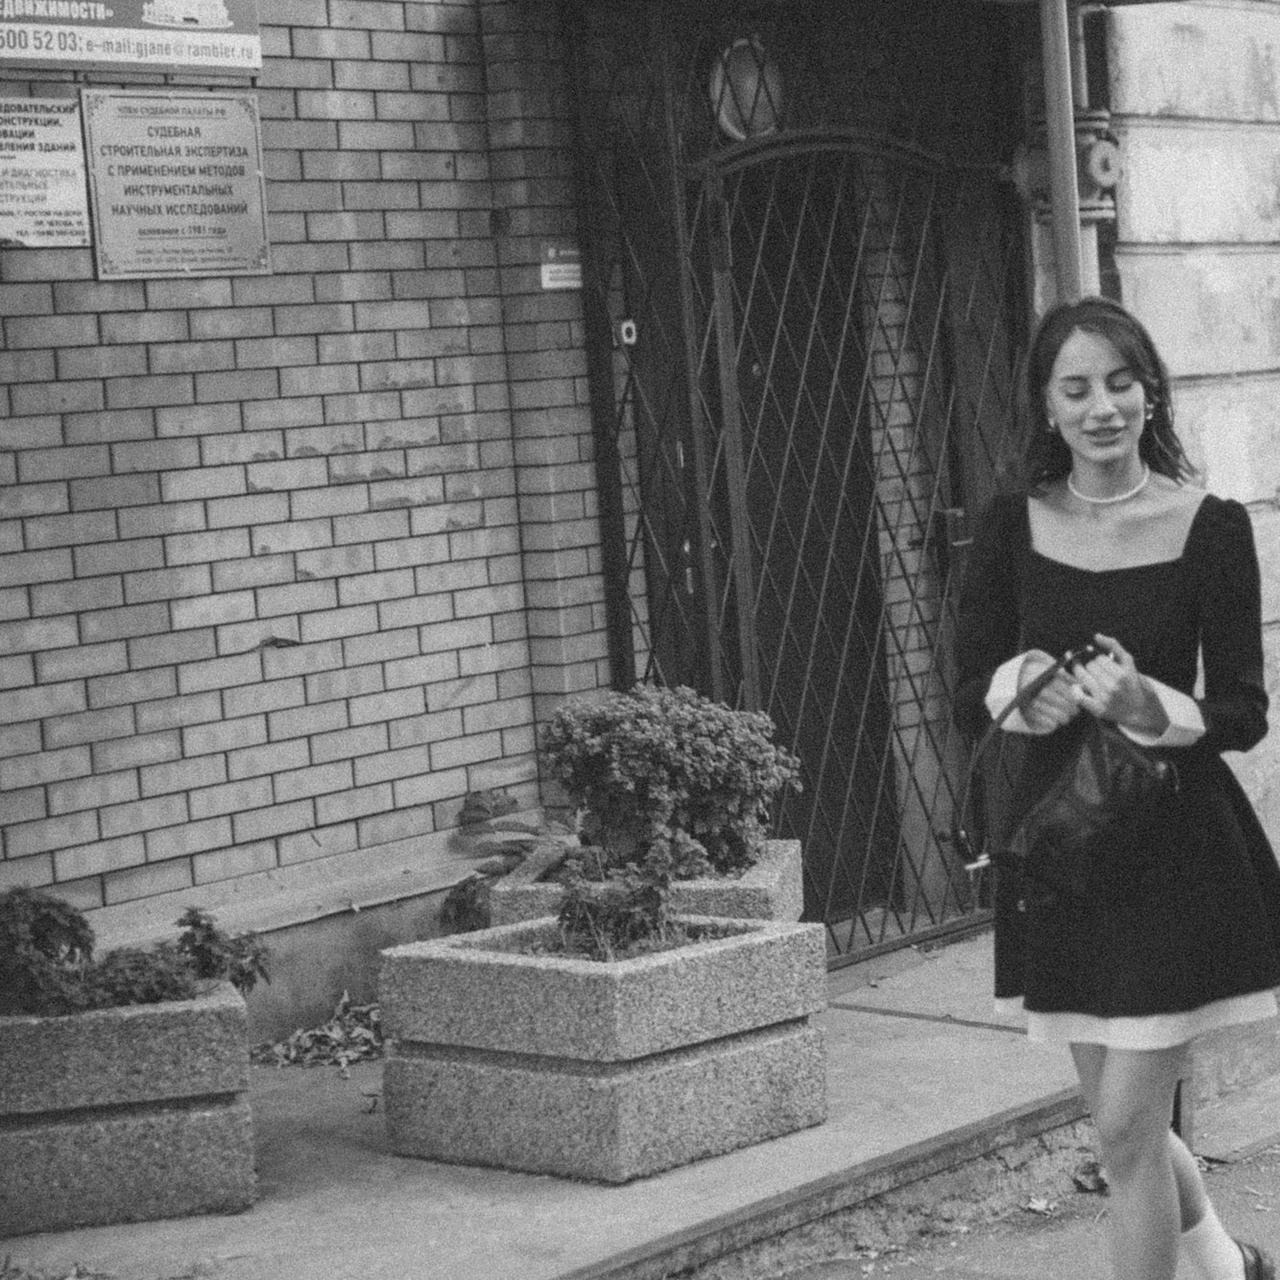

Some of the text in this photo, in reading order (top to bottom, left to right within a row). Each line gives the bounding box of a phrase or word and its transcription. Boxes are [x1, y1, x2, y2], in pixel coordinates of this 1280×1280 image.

[33, 30, 54, 50] 52
[0, 129, 35, 139] ВАЦИИ
[147, 125, 201, 139] СУДЕБНАЯ
[101, 144, 248, 158] СТРОИТЕЛЬНАЯ ЭКСПЕРТИЗА
[108, 164, 246, 178] С ПРИМЕНЕНИЕМ МЕТОДОВ
[124, 183, 234, 197] ИНСТРУМЕНТАЛЬНЫХ
[112, 200, 248, 216] НАУЧНЫХ ИССЛЕДОВАНИЙ
